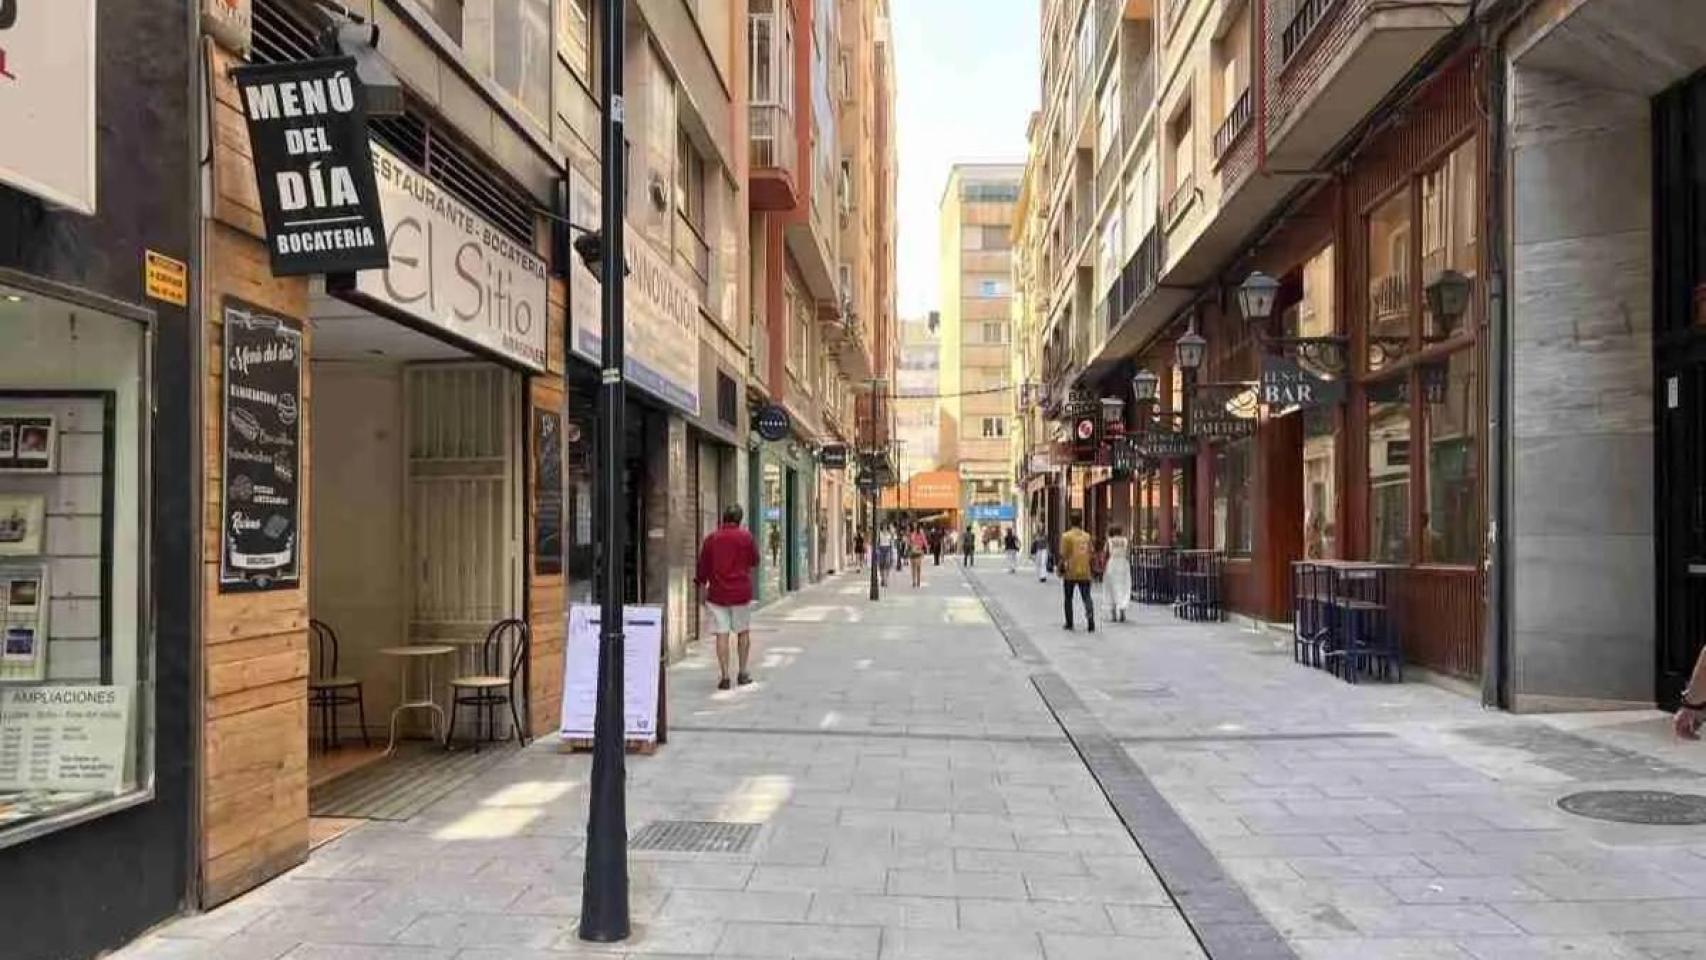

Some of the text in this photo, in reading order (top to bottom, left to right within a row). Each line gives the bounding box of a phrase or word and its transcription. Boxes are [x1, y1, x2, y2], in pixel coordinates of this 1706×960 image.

[246, 71, 354, 120] MENÚ
[285, 127, 332, 155] DEL
[276, 161, 360, 210] DÍA
[277, 226, 374, 254] BOCATERÍA
[383, 216, 532, 335] El Sitio
[1265, 383, 1311, 402] BAR
[13, 689, 115, 704] AMPLIACIONES
